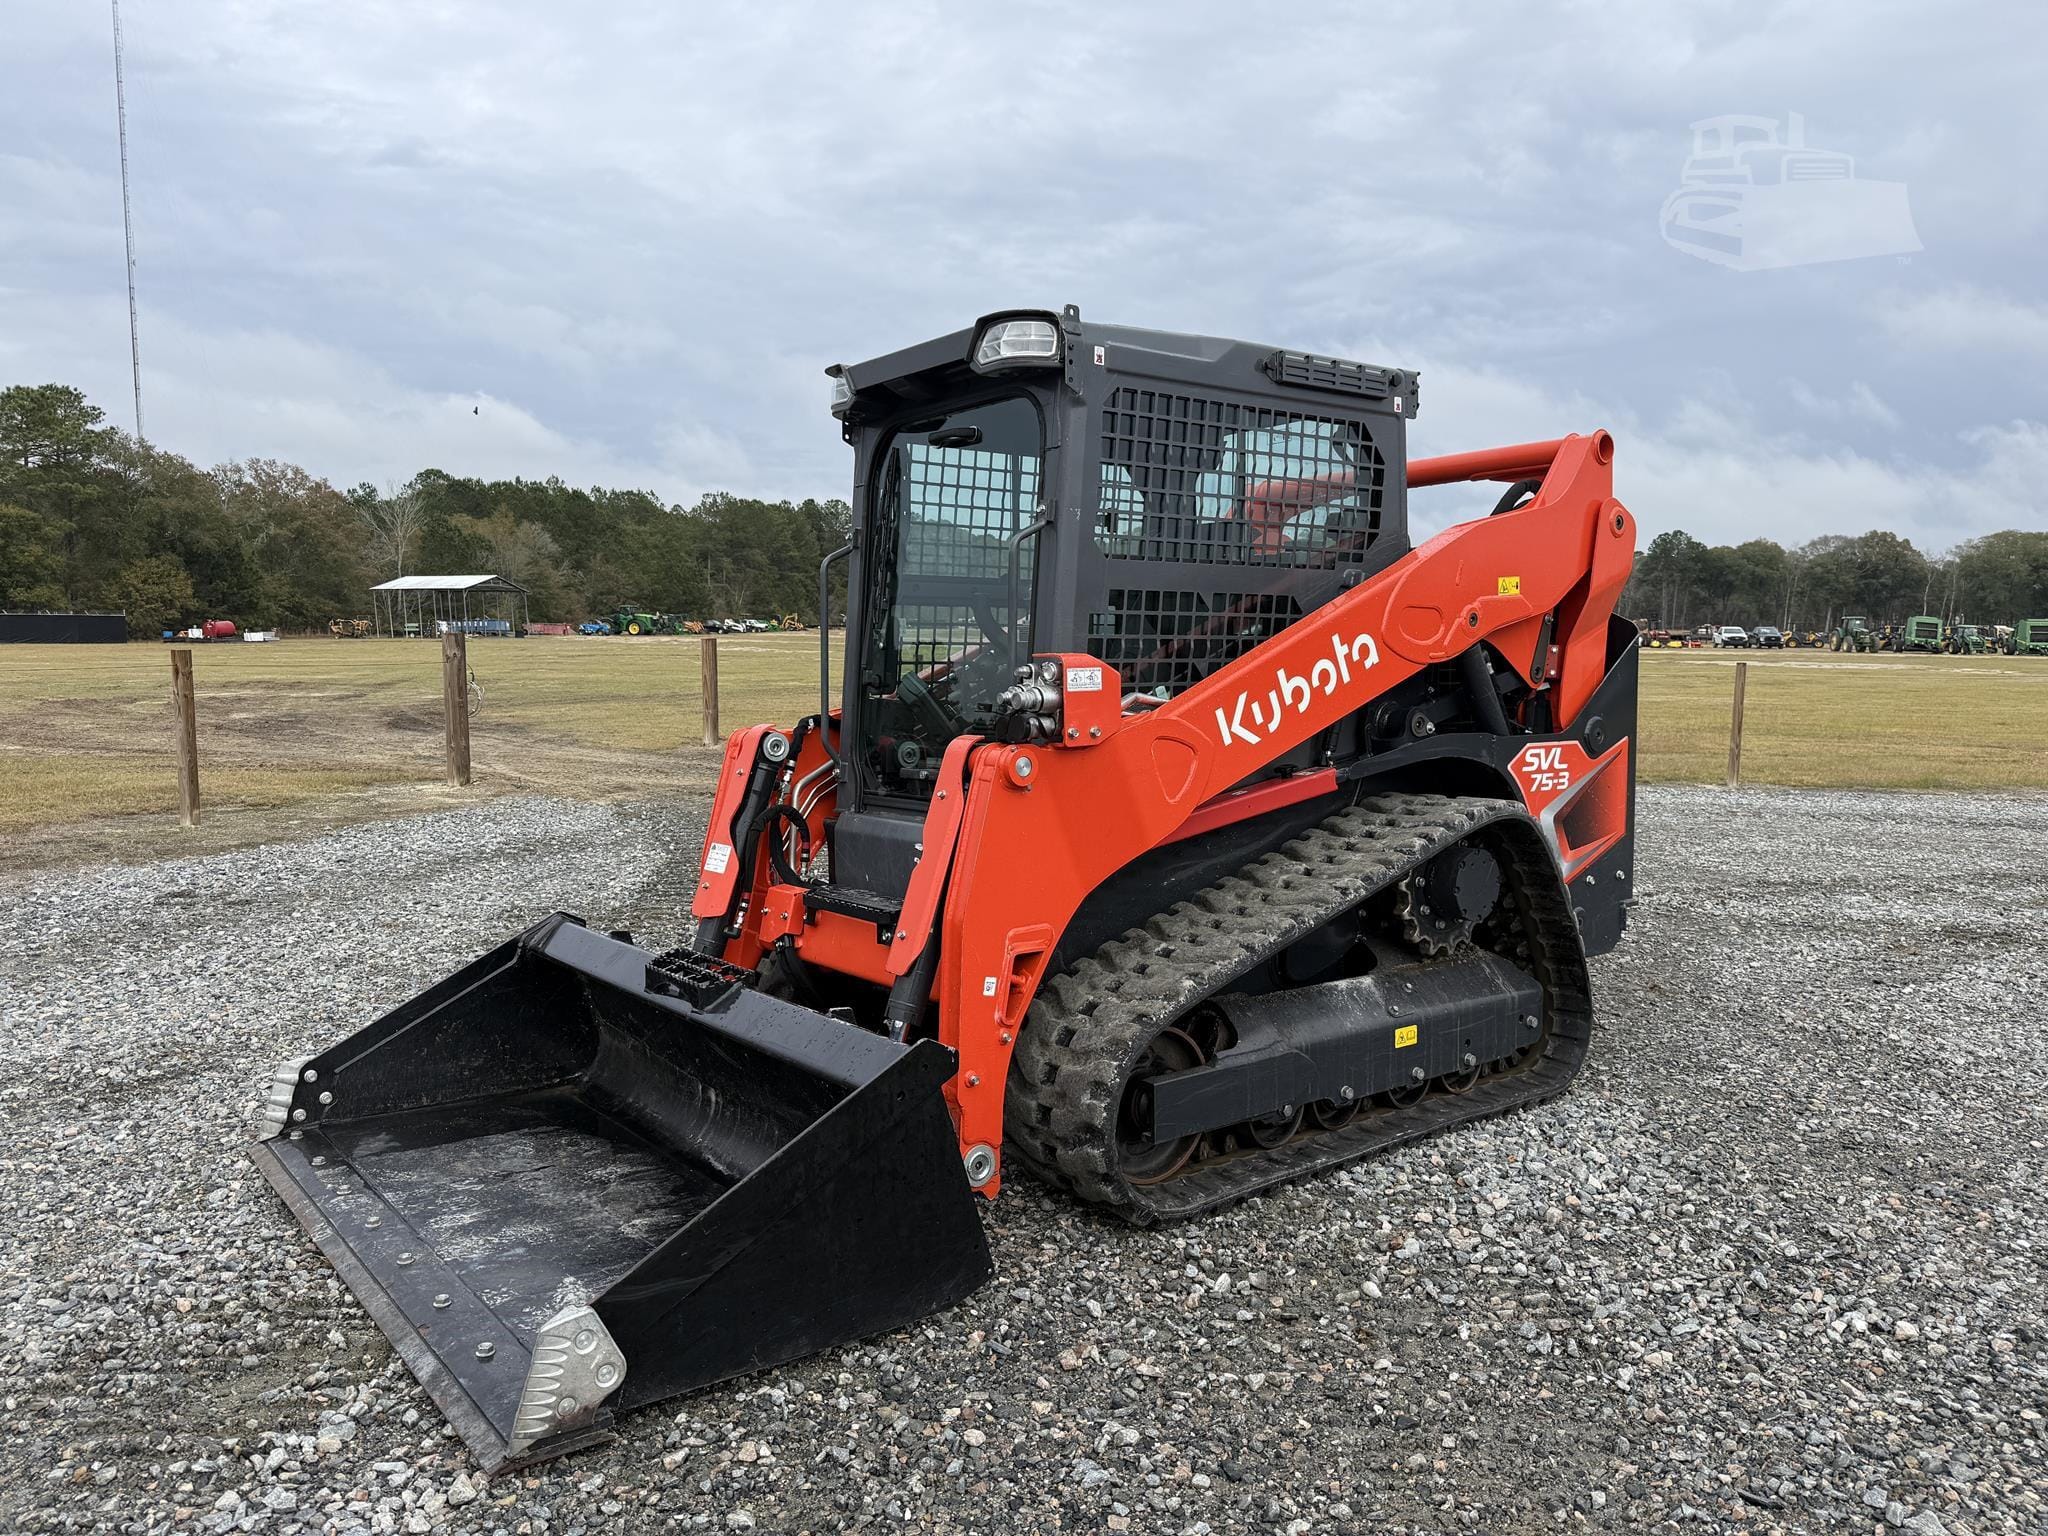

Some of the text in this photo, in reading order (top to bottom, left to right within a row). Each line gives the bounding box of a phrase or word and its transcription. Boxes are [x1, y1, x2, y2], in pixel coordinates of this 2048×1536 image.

[1215, 633, 1379, 746] Kubota
[1522, 747, 1568, 772] SVL
[1530, 772, 1569, 792] 75-3
